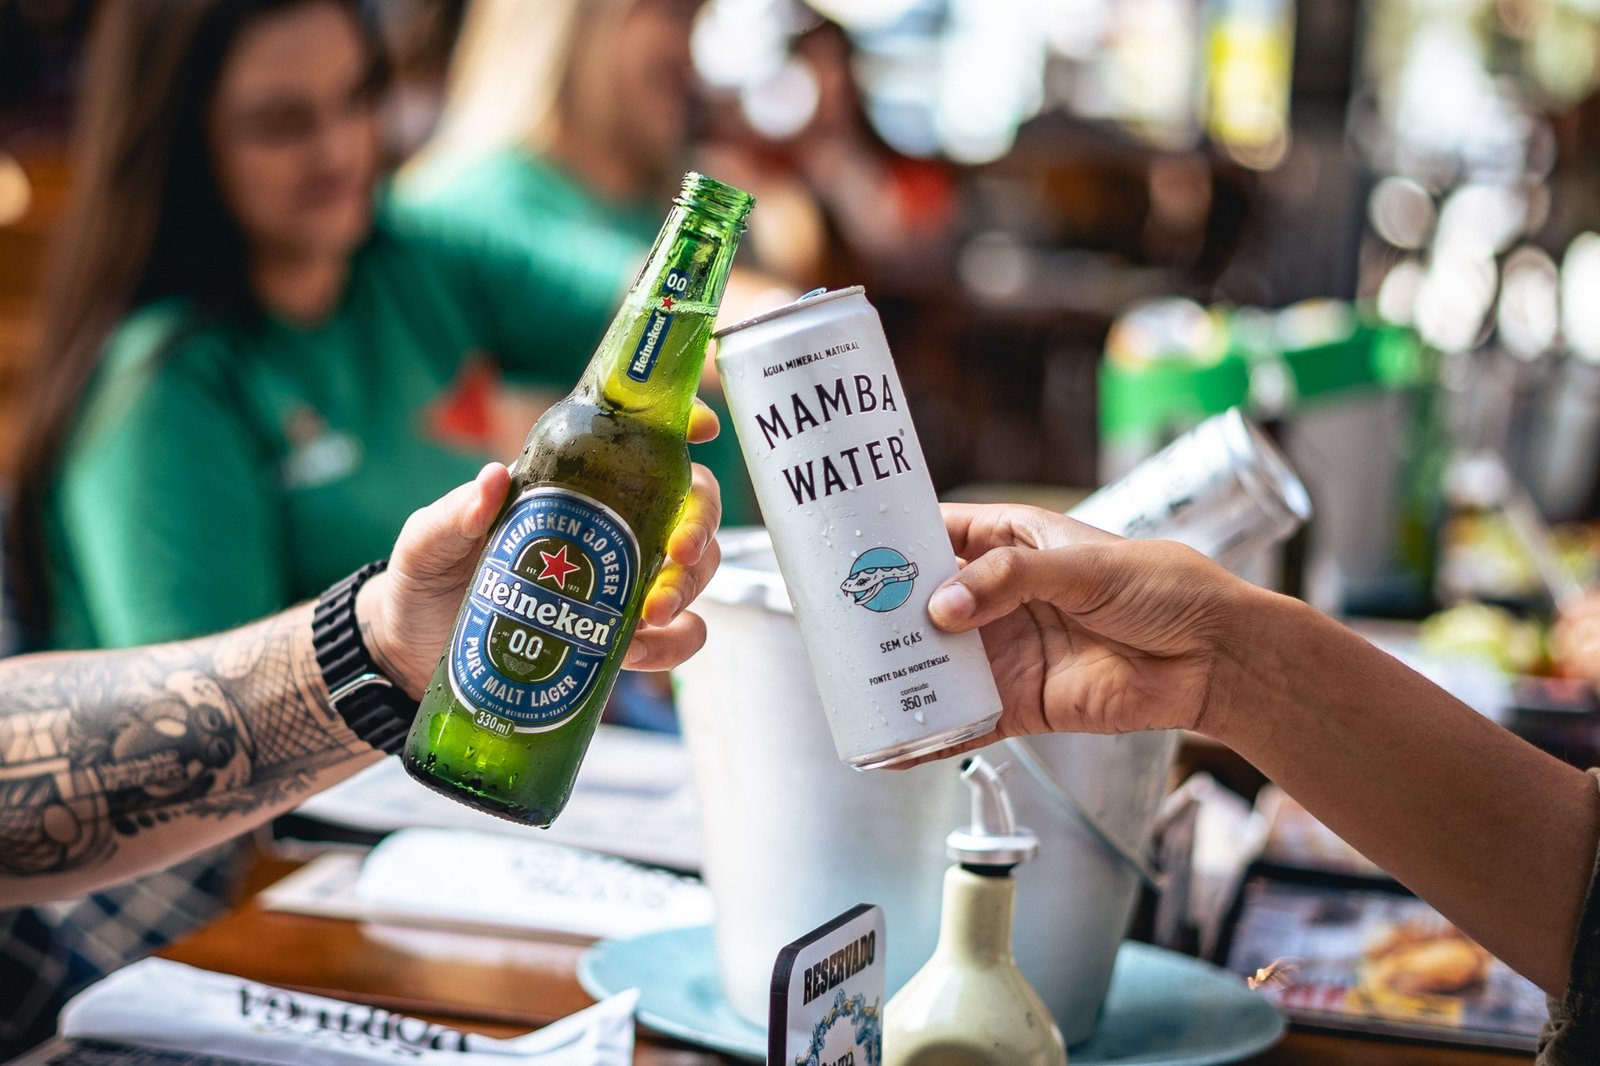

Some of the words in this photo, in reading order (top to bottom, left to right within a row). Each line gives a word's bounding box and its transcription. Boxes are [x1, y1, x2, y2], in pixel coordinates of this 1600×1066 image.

[666, 273, 687, 292] 0.0
[633, 313, 667, 374] Heineken
[763, 364, 784, 378] ÁGUA
[785, 352, 824, 371] MINERAL
[825, 341, 860, 358] NATURAL
[755, 374, 897, 450] MAMBA
[782, 435, 912, 505] WATER
[561, 504, 590, 518] QUALITY
[592, 515, 610, 531] LAGER
[611, 531, 624, 546] BEER
[502, 513, 582, 555] HEINEKEN
[601, 550, 619, 596] BEER
[509, 629, 543, 660] 0.0
[880, 638, 901, 653] SEM
[903, 632, 922, 646] GÁS
[466, 637, 486, 680] PURE
[482, 676, 524, 705] MALT
[531, 675, 578, 707] LAGER
[869, 673, 892, 686] FONTE
[892, 668, 907, 679] DAS
[900, 682, 929, 696] conteúdo
[505, 709, 539, 719] HEINEKEN
[901, 695, 922, 712] 350
[923, 690, 937, 705] ml
[476, 711, 510, 735] 330ml
[803, 930, 876, 1006] RESERVADO
